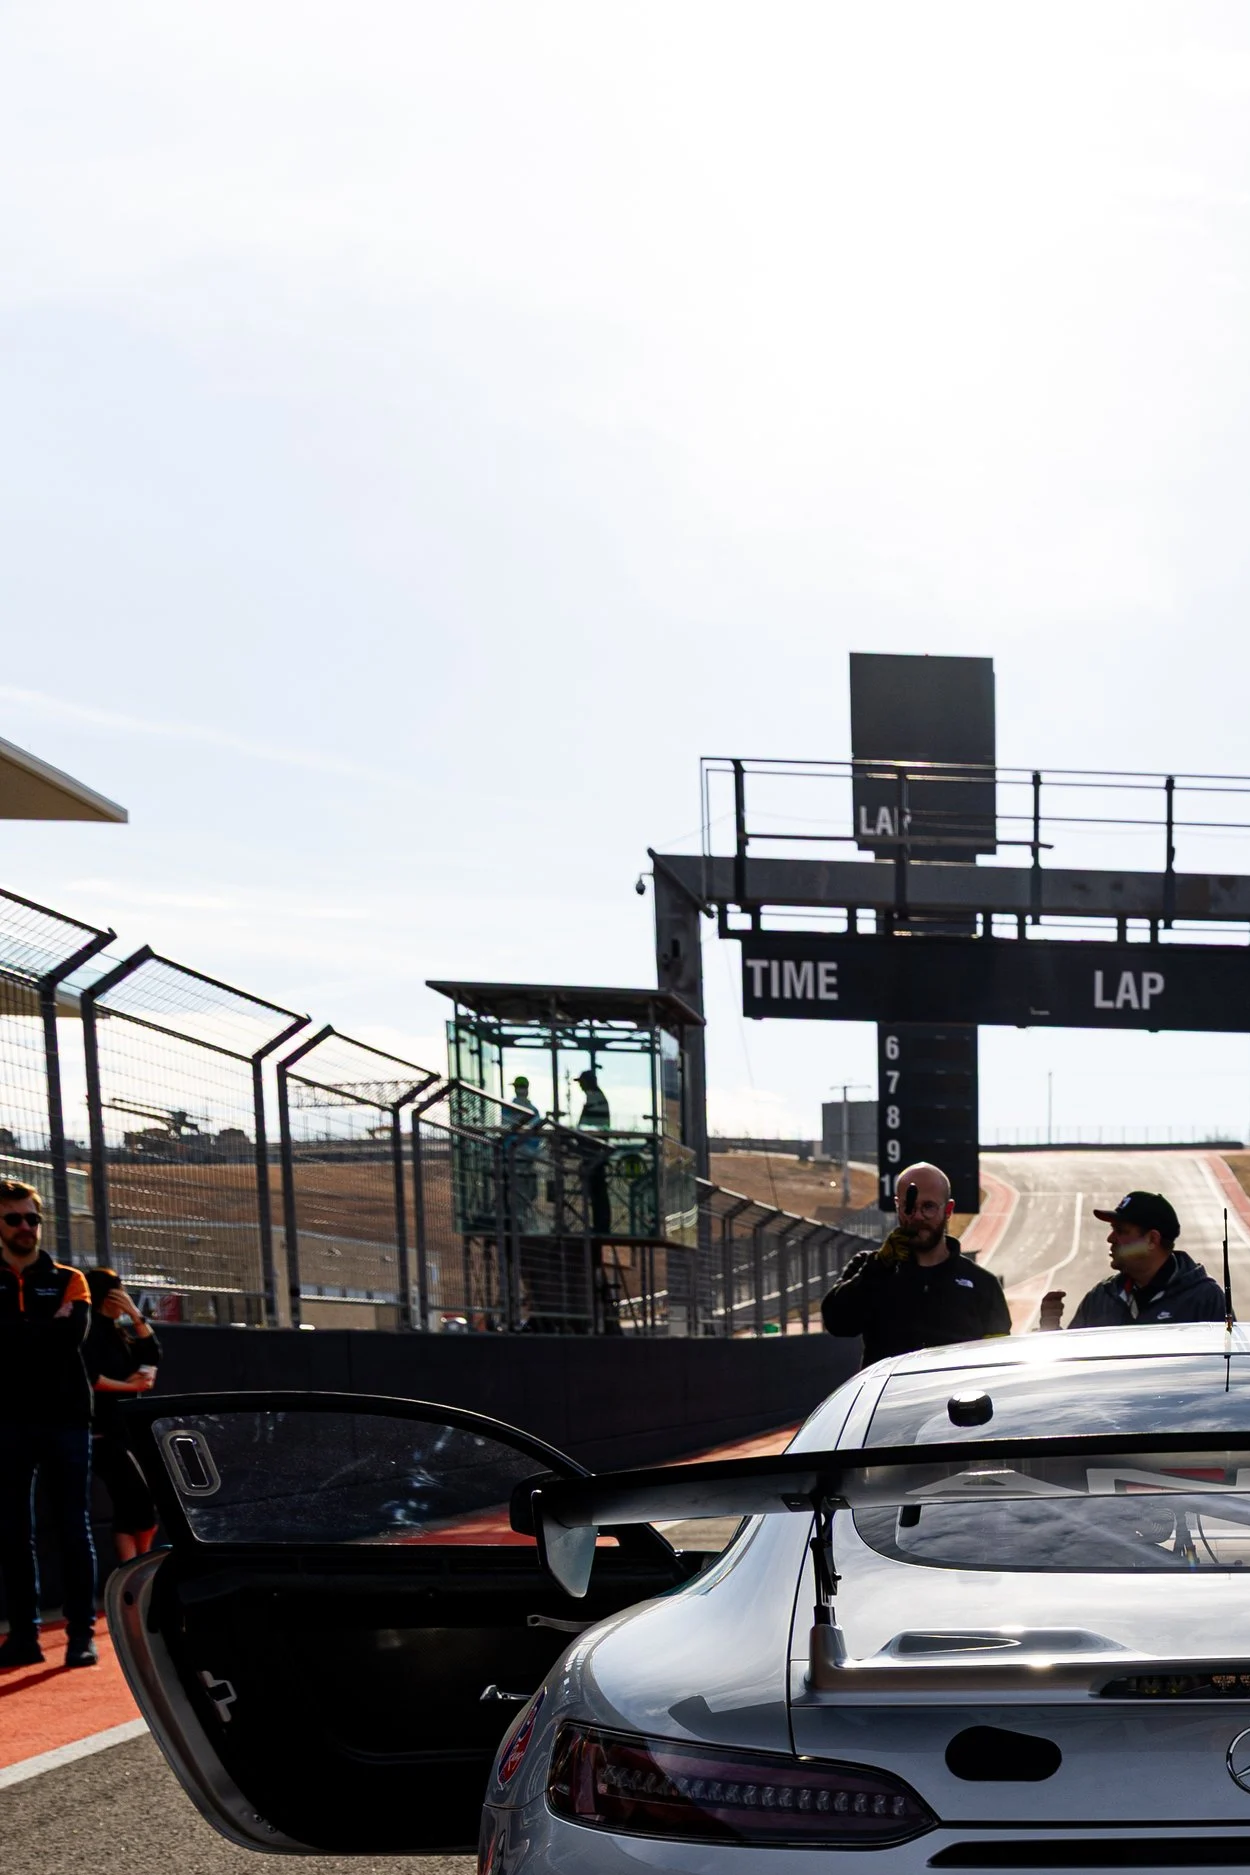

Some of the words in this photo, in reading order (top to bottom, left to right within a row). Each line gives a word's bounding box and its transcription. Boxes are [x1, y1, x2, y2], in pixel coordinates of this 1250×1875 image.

[746, 960, 839, 1000] TIME
[1094, 970, 1166, 1010] LAP
[885, 1035, 900, 1060] 6
[886, 1070, 900, 1094] 7
[886, 1105, 901, 1129] 8
[886, 1139, 901, 1163] 9
[880, 1174, 900, 1197] 1
